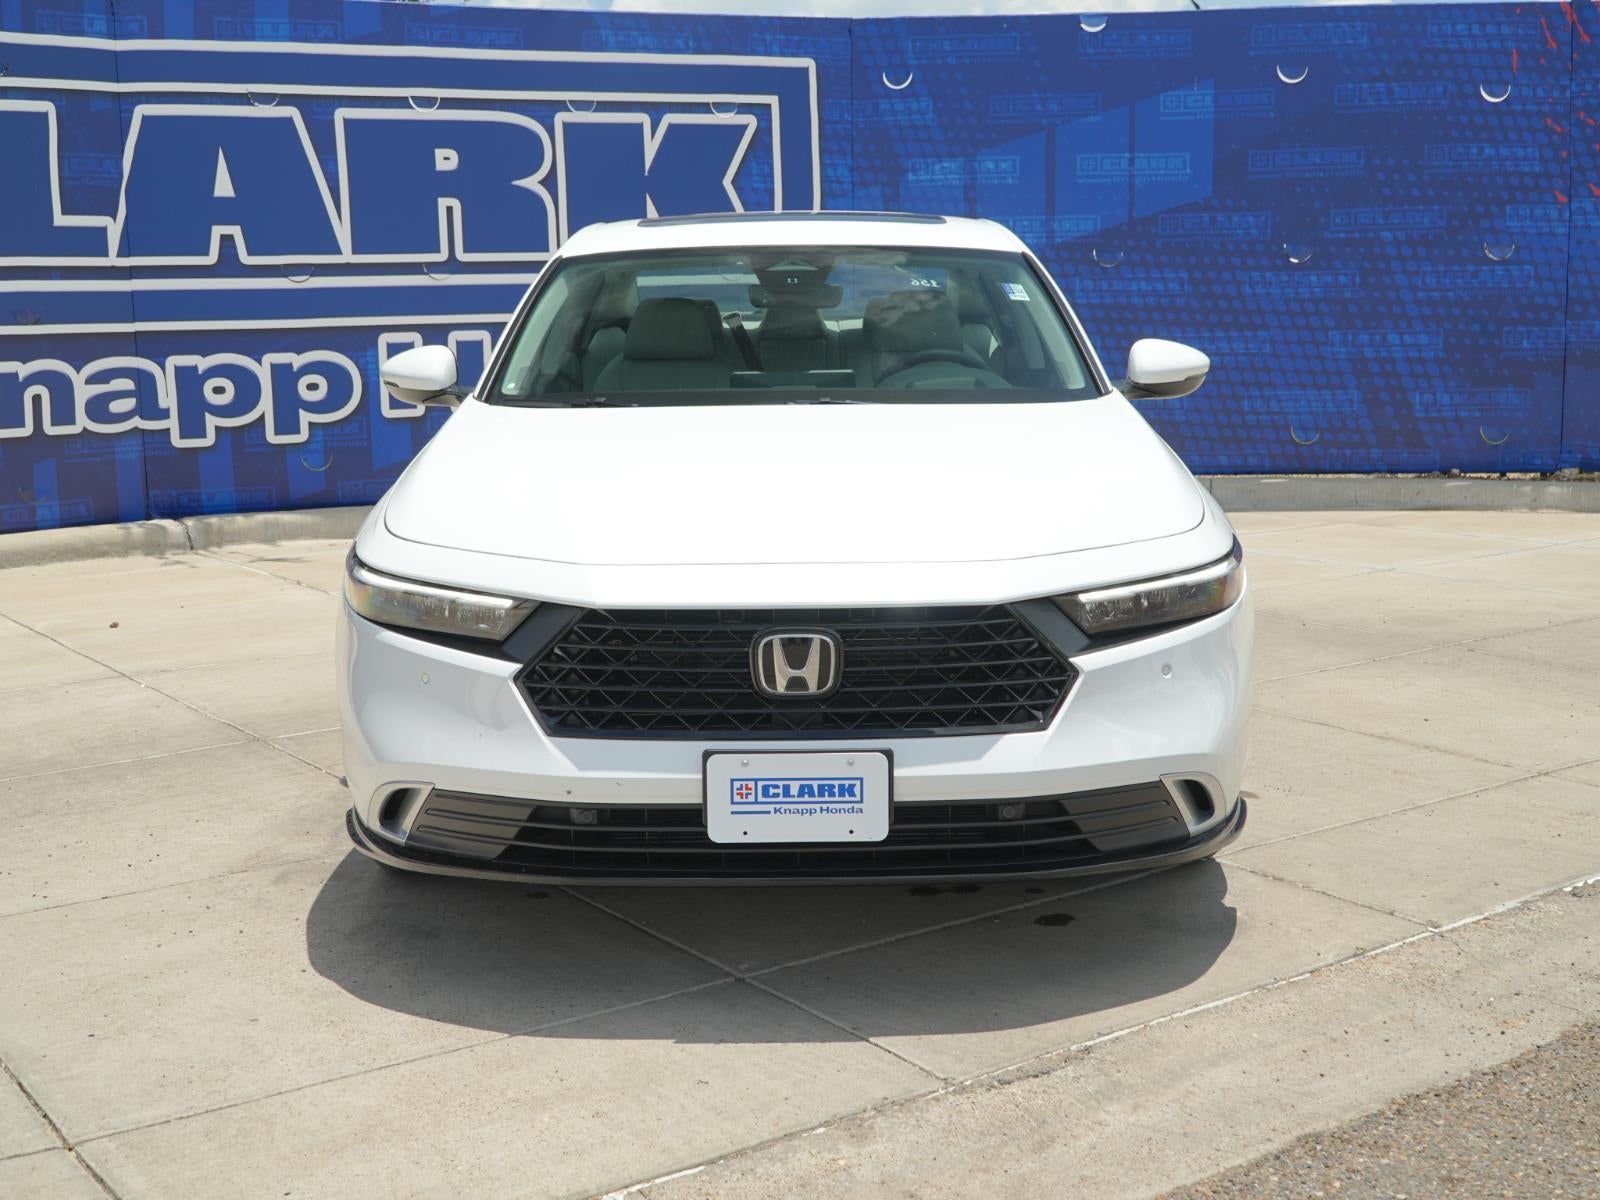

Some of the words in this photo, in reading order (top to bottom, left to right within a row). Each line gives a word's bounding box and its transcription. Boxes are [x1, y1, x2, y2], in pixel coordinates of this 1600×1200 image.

[1103, 156, 1185, 171] CLARK
[761, 783, 857, 799] CLARK
[773, 807, 817, 816] Knapp
[820, 805, 863, 814] Honda
